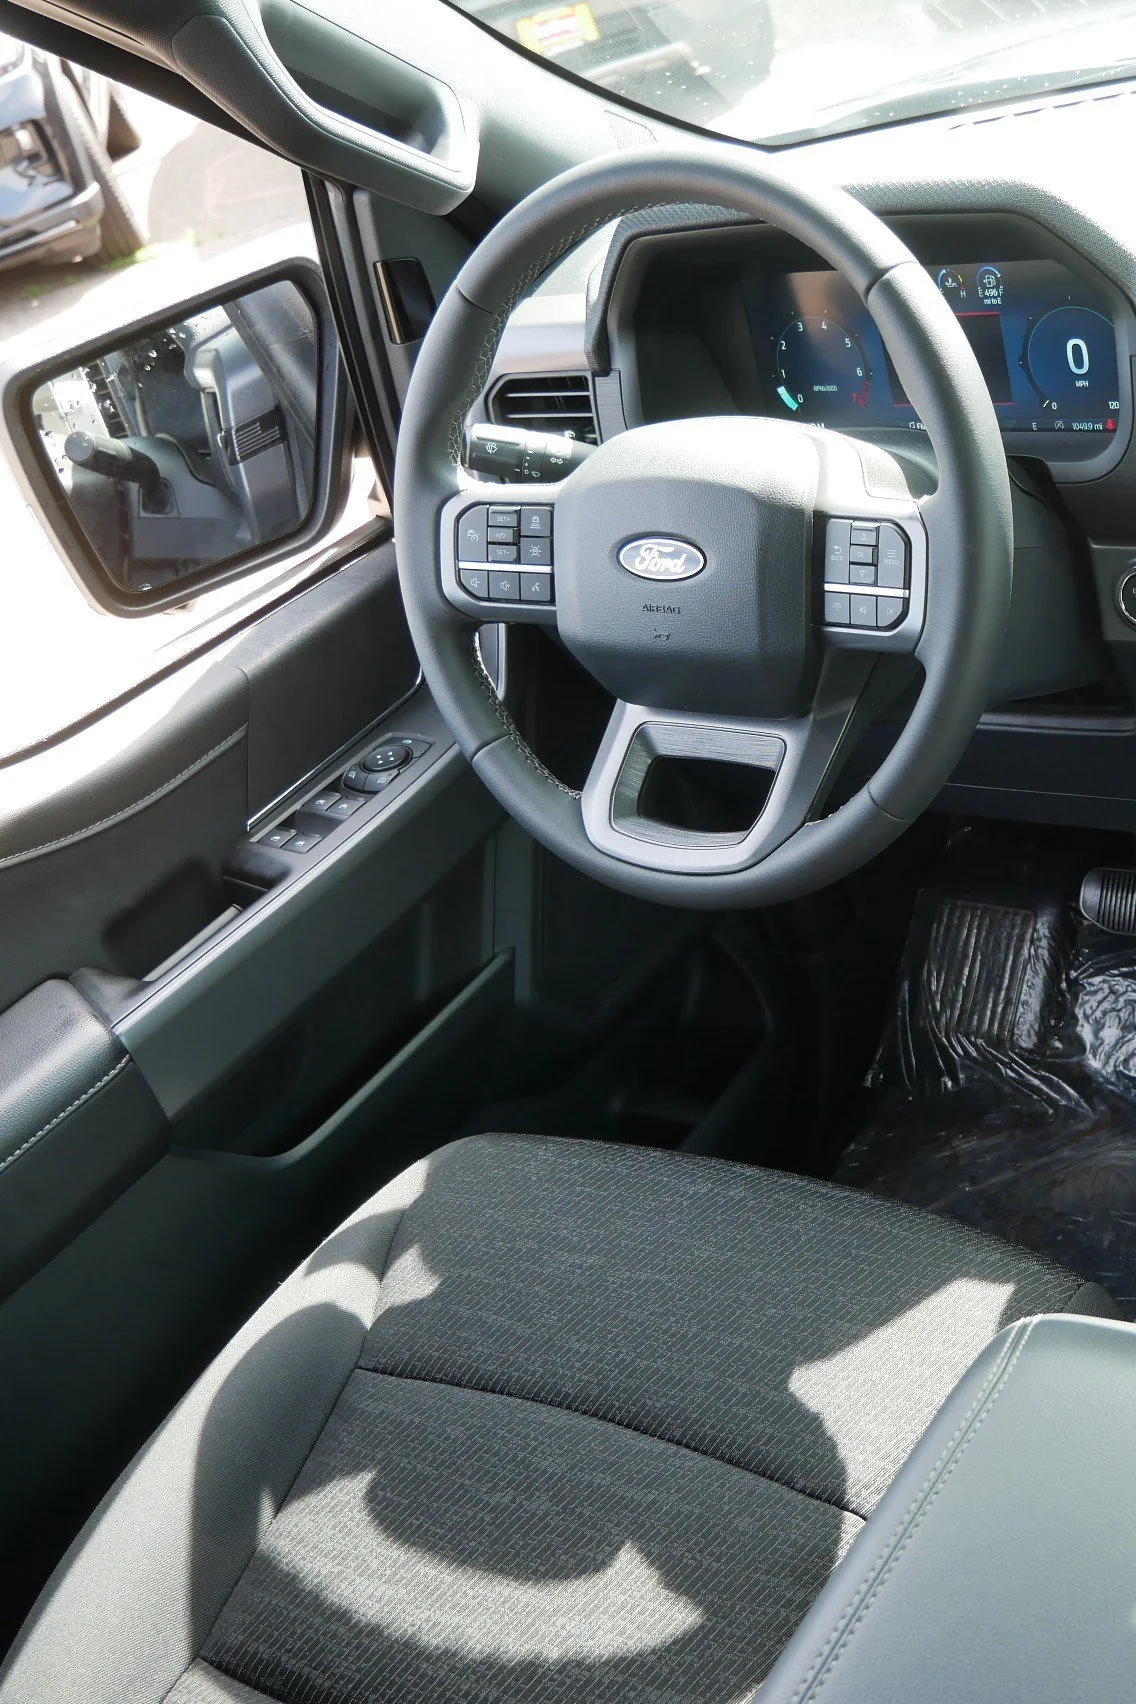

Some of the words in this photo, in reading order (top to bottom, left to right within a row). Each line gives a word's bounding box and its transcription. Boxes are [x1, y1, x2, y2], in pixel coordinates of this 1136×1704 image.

[797, 322, 804, 332] 3
[821, 321, 828, 331] 4
[780, 340, 787, 350] 2
[845, 338, 851, 348] 5
[1066, 338, 1089, 375] 0
[856, 367, 863, 377] 6
[1075, 380, 1089, 388] MPH
[797, 394, 804, 403] 0
[1051, 402, 1058, 410] 0
[1108, 401, 1120, 410] 120
[634, 543, 688, 574] Ford
